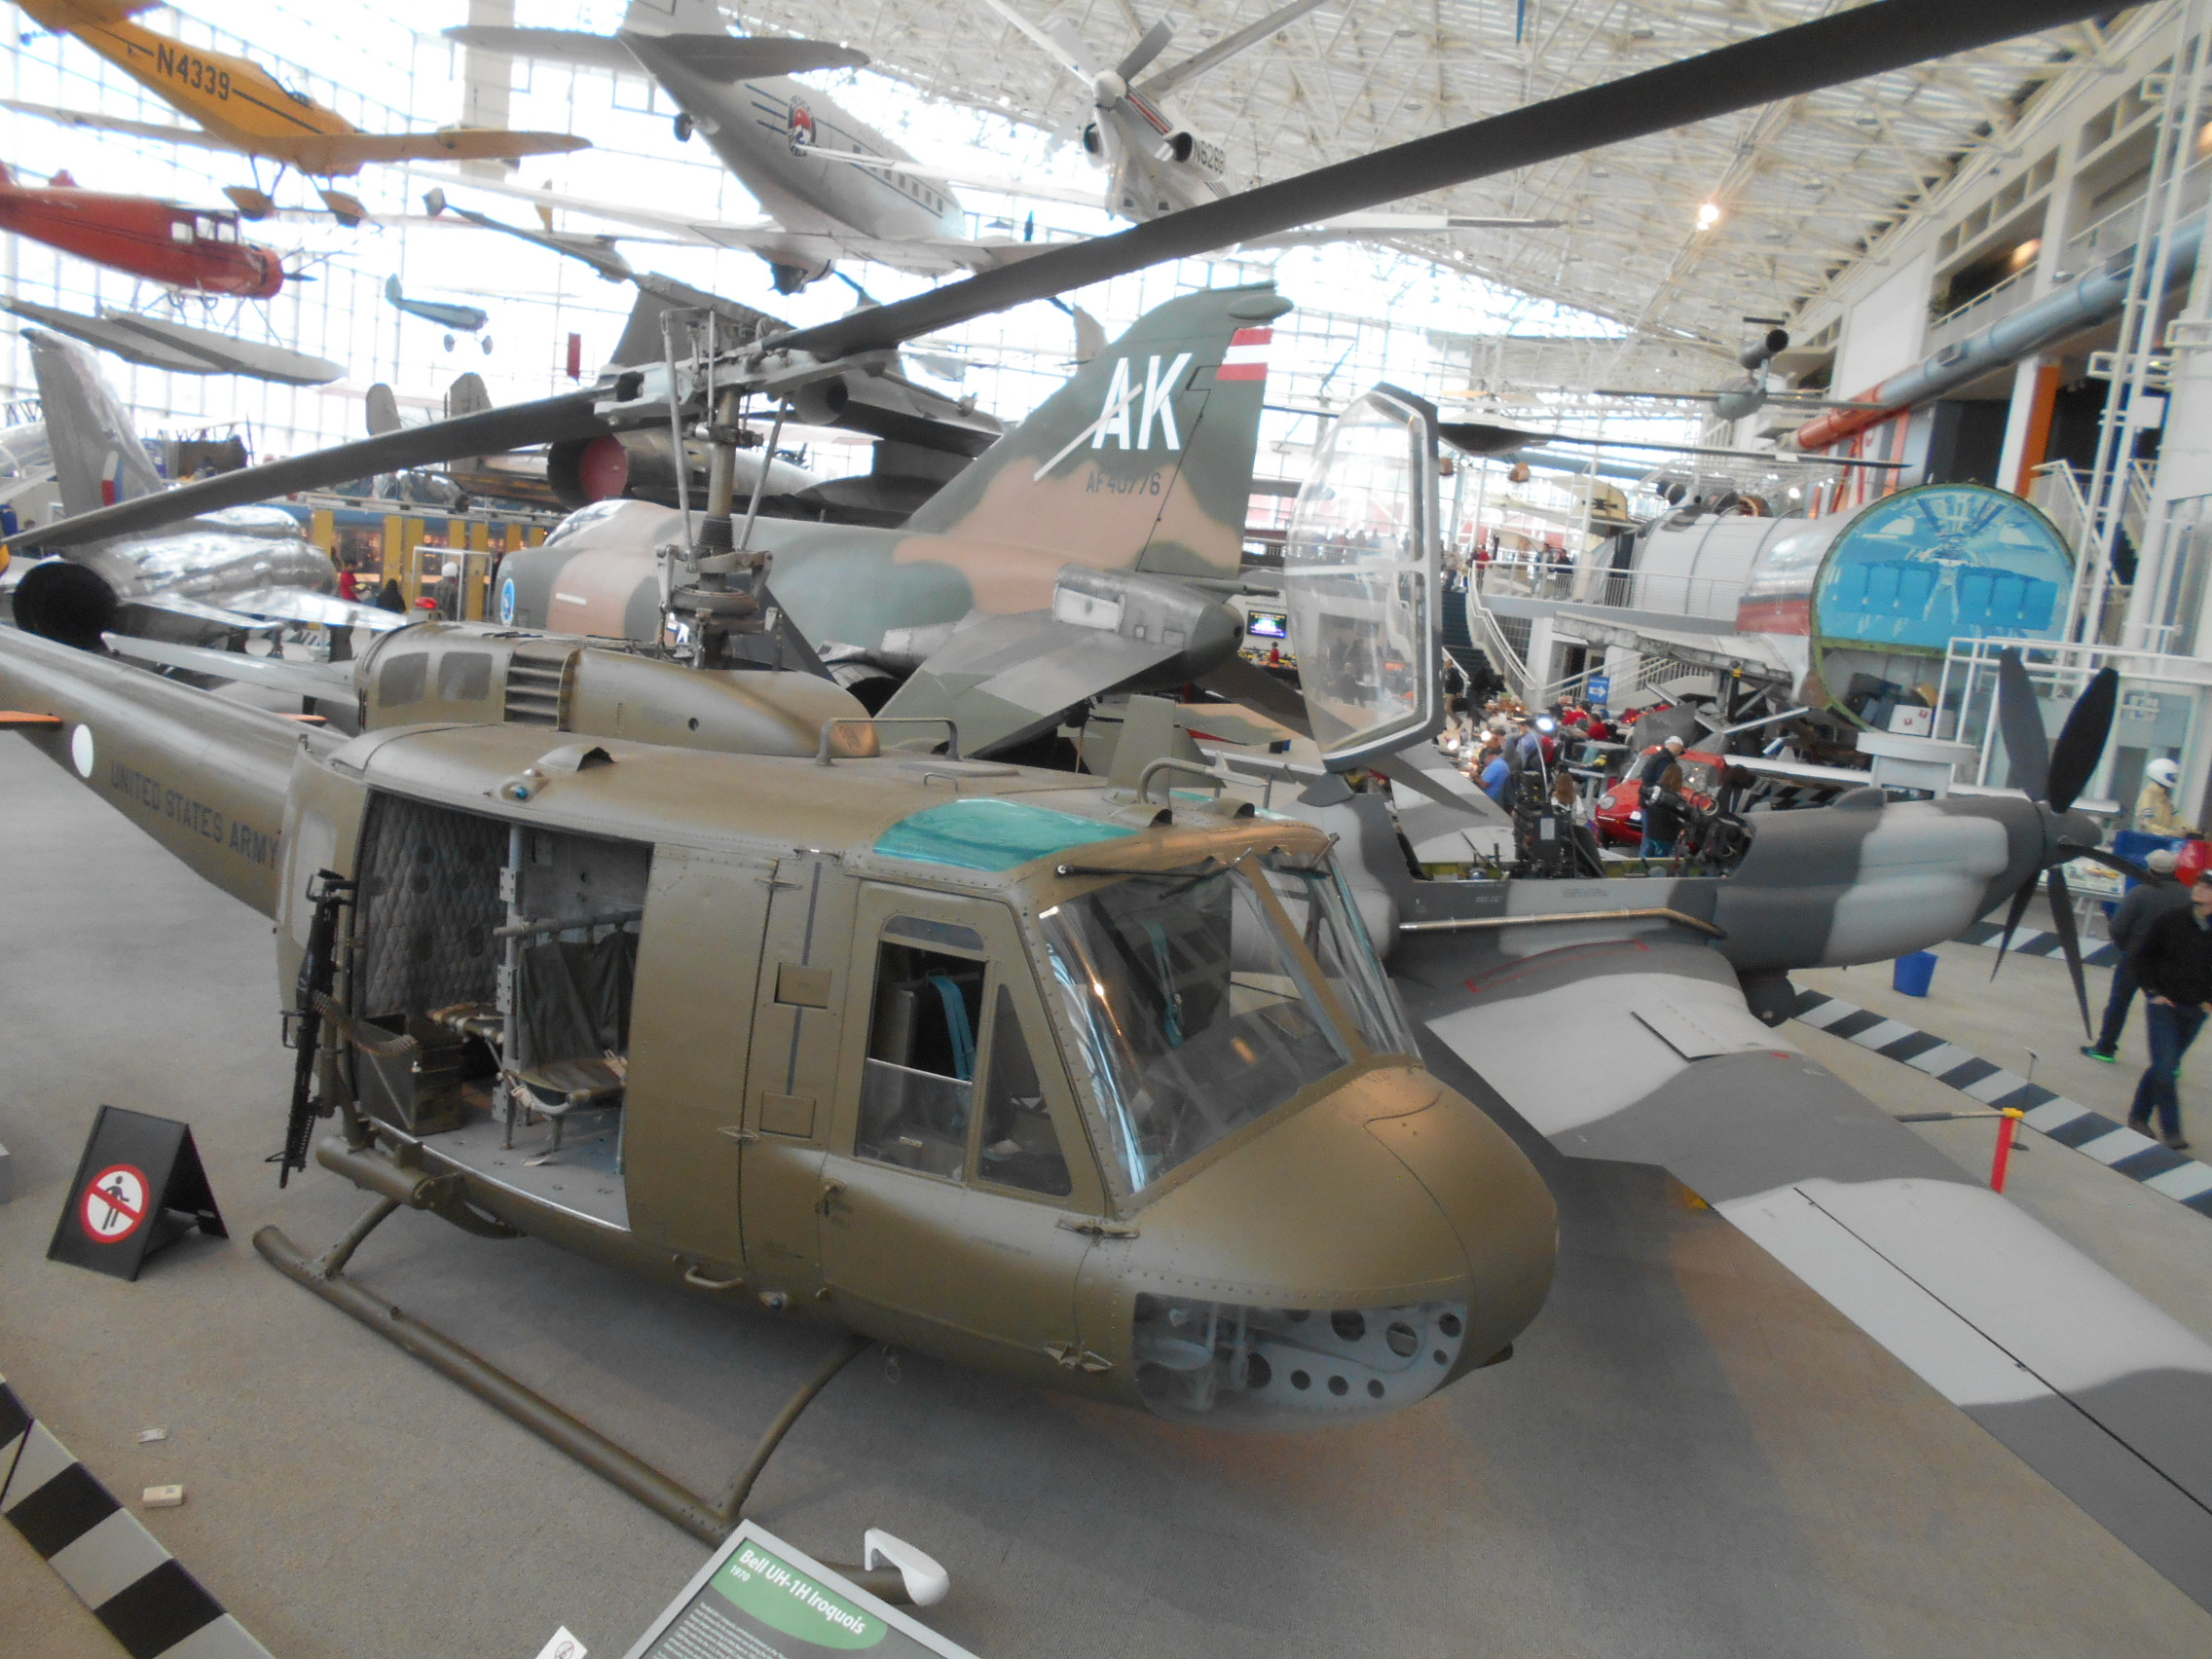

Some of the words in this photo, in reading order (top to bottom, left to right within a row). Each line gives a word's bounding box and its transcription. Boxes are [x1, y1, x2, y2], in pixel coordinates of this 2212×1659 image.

[157, 43, 231, 101] N4339
[1091, 352, 1193, 450] AK
[111, 759, 161, 811] UNITED
[166, 789, 223, 843] STATES
[230, 820, 280, 870] ARMY
[729, 1565, 752, 1583] 1970
[739, 1549, 768, 1573] Bell
[764, 1566, 812, 1602] UH-1H
[807, 1588, 866, 1636] Iroquois
